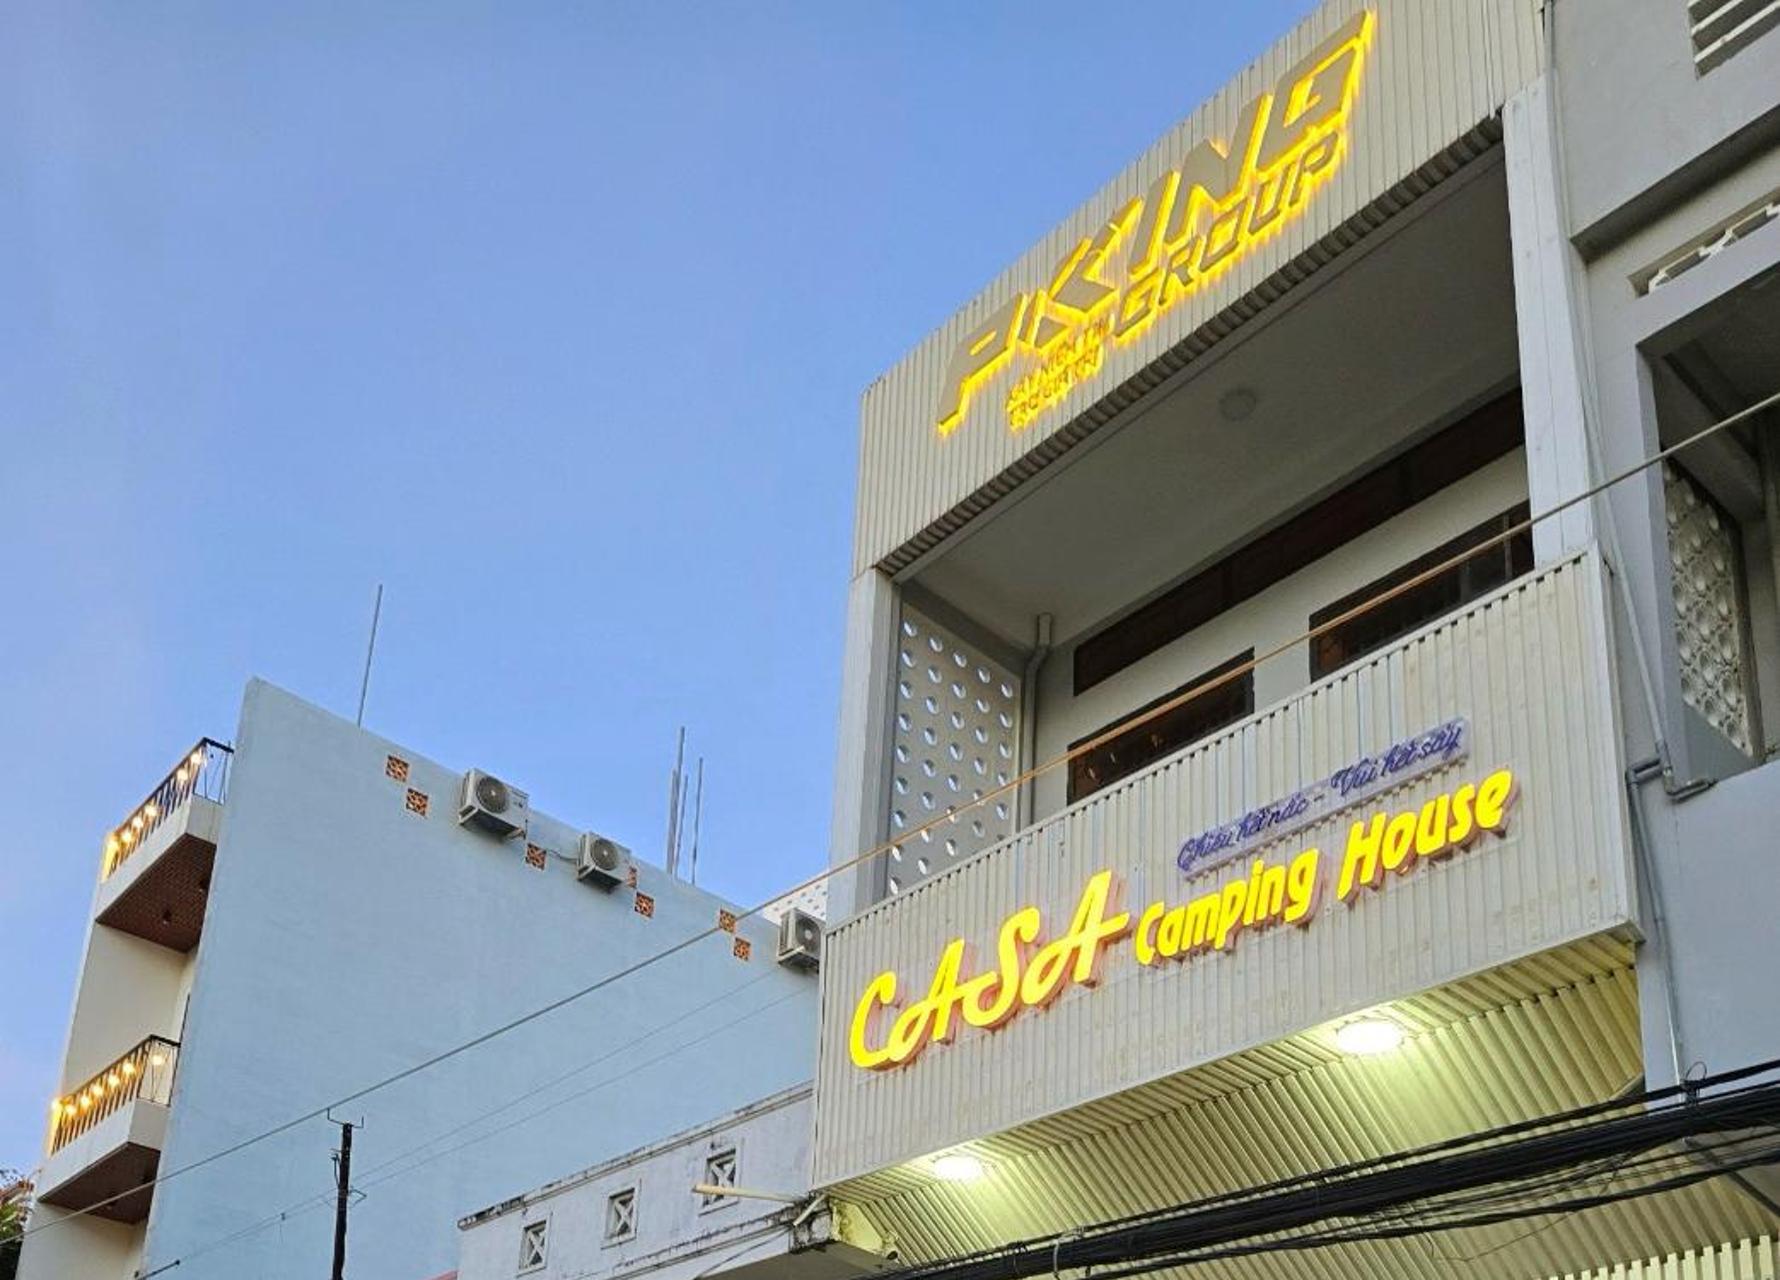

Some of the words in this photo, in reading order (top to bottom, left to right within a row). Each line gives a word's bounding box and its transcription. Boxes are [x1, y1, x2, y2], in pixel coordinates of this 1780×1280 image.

[1111, 130, 1343, 342] GROUP
[849, 868, 1131, 1070] CASA
[1135, 846, 1321, 966] Camping
[1336, 769, 1515, 902] House
